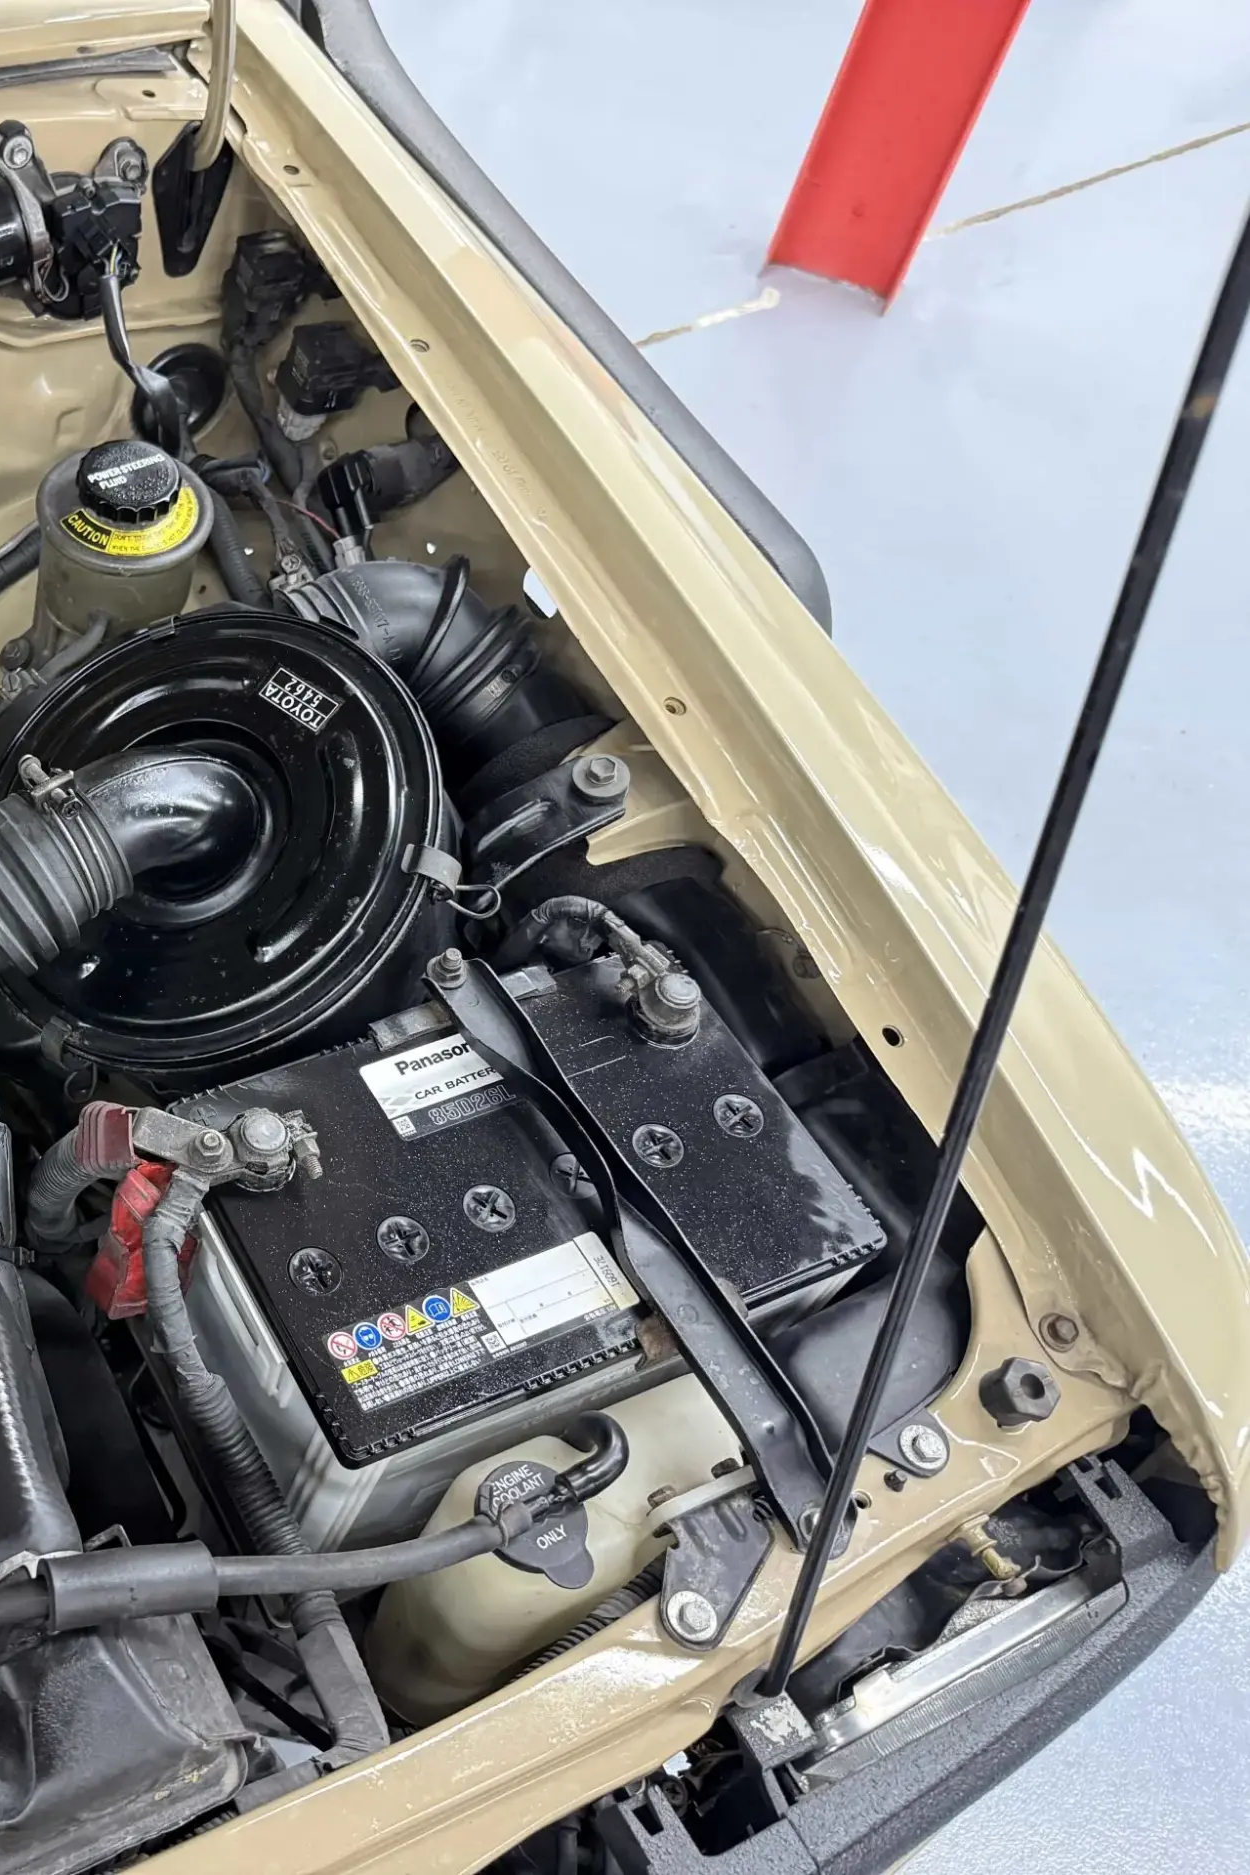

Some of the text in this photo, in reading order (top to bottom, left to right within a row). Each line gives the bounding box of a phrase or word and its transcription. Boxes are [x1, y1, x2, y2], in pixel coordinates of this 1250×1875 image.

[87, 454, 165, 484] POWER STEERING
[99, 476, 128, 490] FLUID
[67, 514, 109, 546] CAUTION
[264, 684, 322, 728] TOYOTA
[284, 678, 323, 707] 5462
[415, 1066, 497, 1100] CAR BATTER
[428, 1085, 517, 1125] 85D26L
[492, 1465, 534, 1495] ENGINE
[536, 1525, 568, 1550] ONLY
